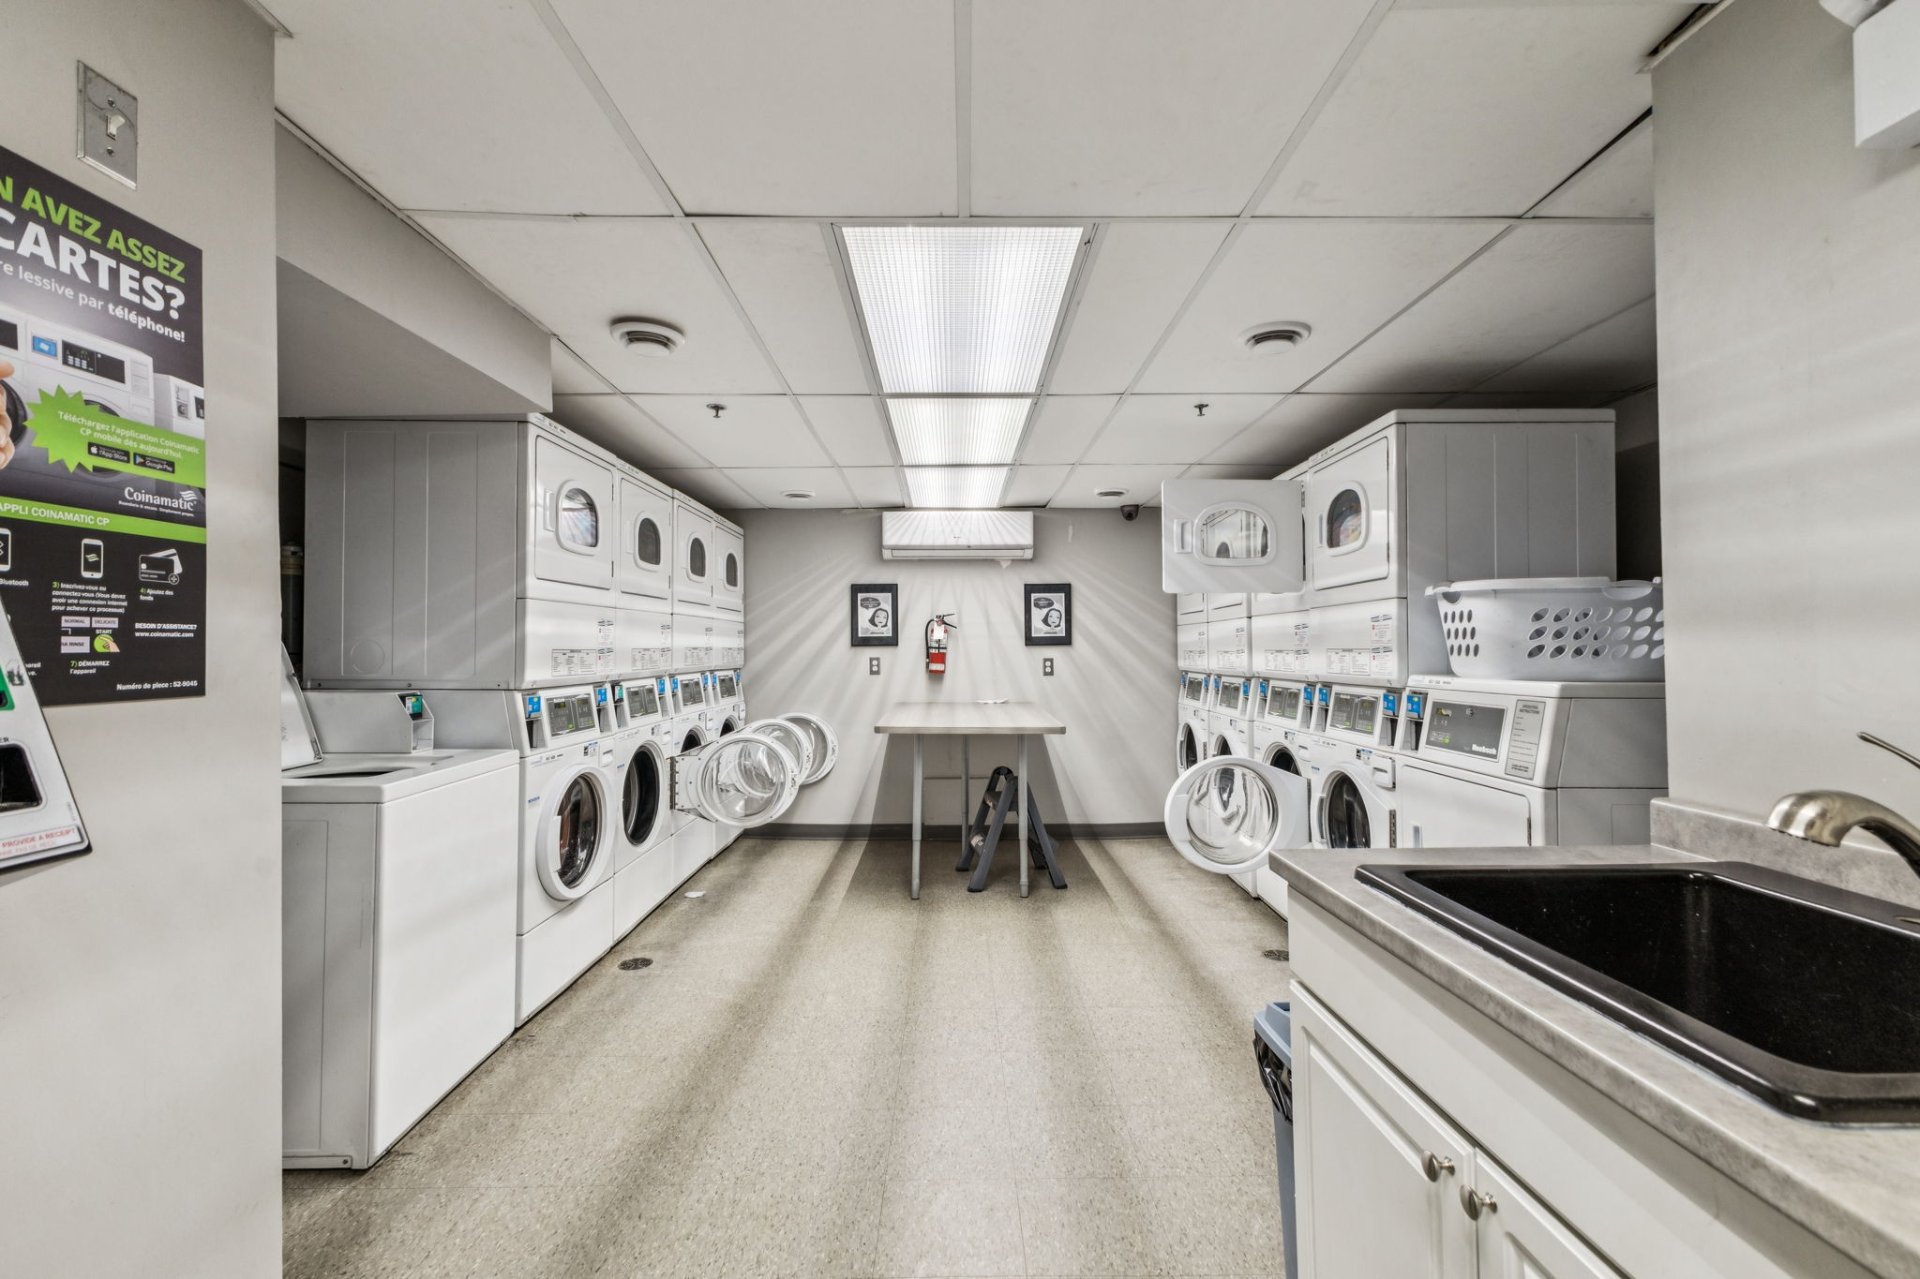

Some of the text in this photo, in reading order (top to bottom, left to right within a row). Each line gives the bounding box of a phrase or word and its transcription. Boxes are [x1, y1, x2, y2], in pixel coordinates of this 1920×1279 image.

[21, 187, 102, 244] AVEZ
[106, 229, 186, 282] ASSEZ
[20, 266, 75, 299] lessive
[78, 292, 104, 313] par
[108, 304, 186, 343] téléphone!
[32, 507, 94, 524] COINAMATIC
[96, 518, 110, 526] CP
[124, 486, 195, 511] Coinamatic
